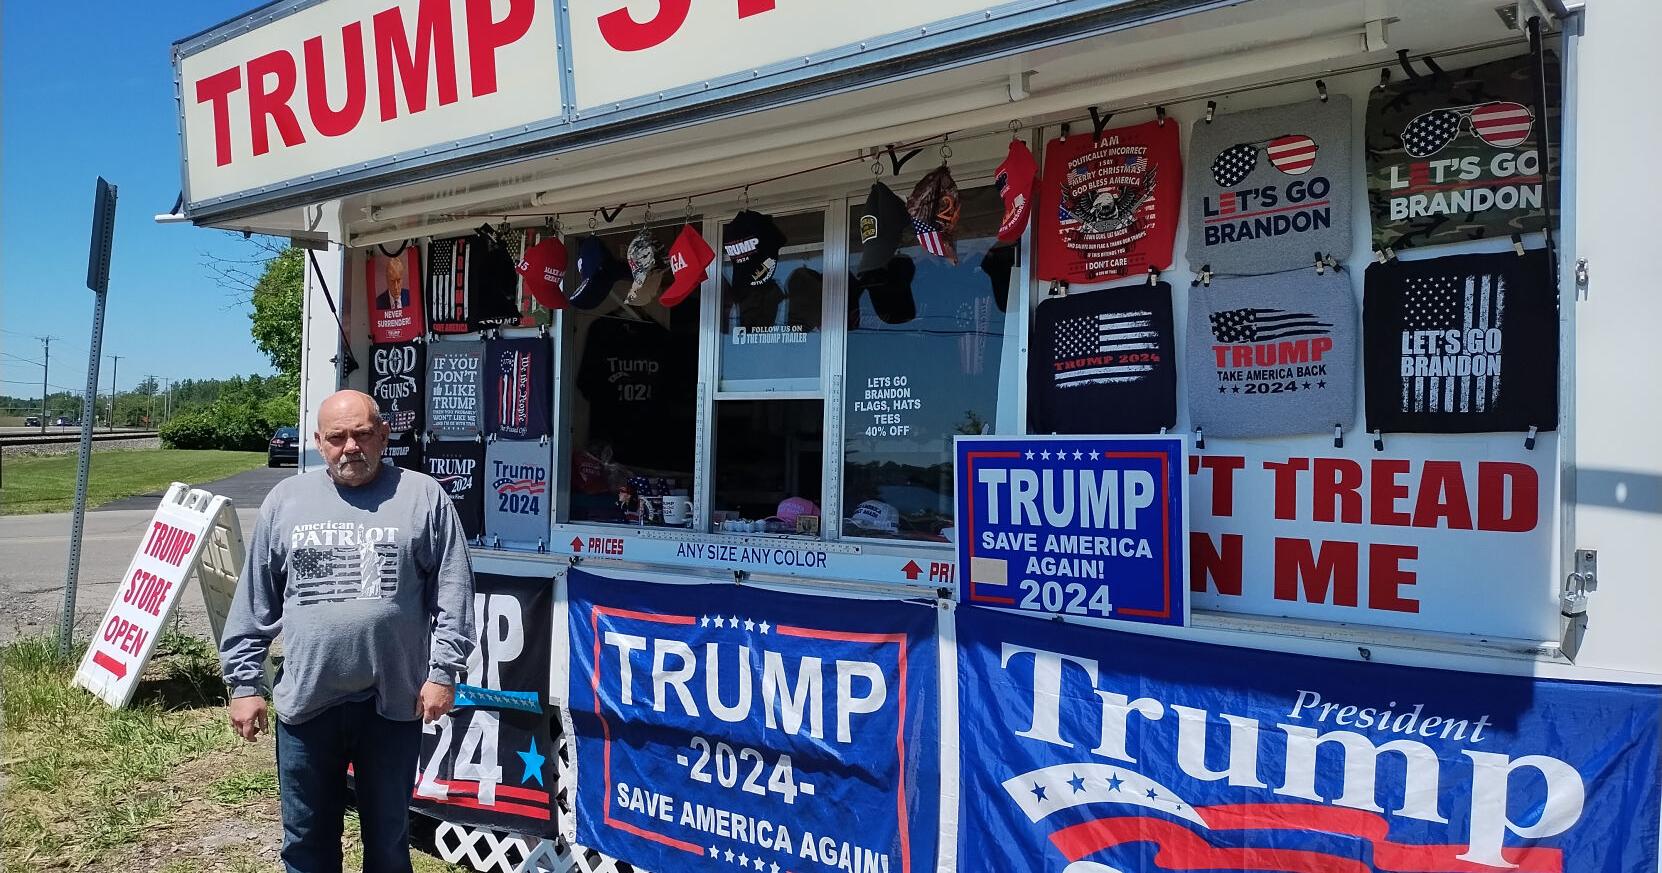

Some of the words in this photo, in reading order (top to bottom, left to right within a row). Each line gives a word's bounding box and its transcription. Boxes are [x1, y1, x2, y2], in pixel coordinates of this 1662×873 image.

[196, 0, 536, 167] TRUMP
[1100, 136, 1119, 148] AM
[1068, 149, 1108, 169] POLITICALLY
[1108, 146, 1148, 156] INCORRECT
[1071, 170, 1096, 186] MERRY
[1098, 165, 1141, 176] CHRISTMAS
[1390, 156, 1481, 189] LET'S
[1490, 150, 1540, 177] GO
[1072, 184, 1087, 197] GOD
[1088, 178, 1108, 190] BLESS
[1109, 176, 1140, 186] AMERICA
[1203, 186, 1278, 217] LET'S
[1286, 177, 1330, 202] GO
[1390, 185, 1542, 220] BRANDON
[1204, 208, 1330, 246] BRANDON
[1089, 260, 1109, 270] DON'T
[1110, 258, 1128, 267] CARE
[384, 310, 403, 319] NEVER
[747, 334, 758, 344] THE
[759, 333, 780, 344] TRUMP
[781, 332, 807, 343] TRAILER
[791, 324, 802, 332] ON
[1401, 329, 1460, 354] LET'S
[1467, 328, 1501, 354] GO
[374, 346, 416, 377] GOD
[1054, 356, 1113, 371] TRUMP
[1119, 353, 1160, 363] 2024
[1212, 337, 1333, 368] TRUMP
[433, 358, 446, 370] IF
[448, 358, 478, 370] YOU
[607, 357, 659, 376] Trump
[1217, 370, 1243, 381] TAKE
[1246, 368, 1293, 380] AMERICA
[1296, 364, 1327, 378] BACK
[1401, 355, 1501, 377] BRANDON
[433, 370, 477, 383] DON'T
[868, 377, 890, 388] LETS
[893, 376, 907, 387] GO
[1244, 380, 1298, 394] 2024
[380, 382, 410, 399] GUNS
[444, 384, 476, 396] LIKE
[864, 387, 911, 399] BRANDON
[391, 399, 400, 411] &
[432, 397, 476, 409] TRUMP
[854, 401, 890, 412] FLAGS,
[893, 399, 921, 410] HATS
[874, 414, 901, 424] TEES
[865, 426, 887, 437] 40%
[890, 426, 910, 436] OFF
[389, 446, 410, 456] TRUMP
[430, 458, 476, 475] TRUMP
[493, 460, 545, 483] Trump
[451, 476, 473, 493] 2024
[1263, 457, 1539, 533] TREAD
[499, 493, 540, 515] 2024
[978, 468, 1155, 530] TRUMP
[293, 520, 354, 532] American
[144, 521, 196, 568] TRUMP
[588, 537, 624, 555] PRICES
[982, 531, 1038, 552] SAVE
[1044, 534, 1153, 559] AMERICA
[677, 542, 705, 558] ANY
[707, 544, 737, 561] SIZE
[740, 548, 770, 564] ANY
[774, 549, 827, 569] COLOR
[1026, 556, 1104, 579] AGAIN!
[1273, 536, 1421, 614] ME
[123, 568, 173, 617] STORE
[1020, 579, 1113, 616] 2024
[103, 615, 148, 658] OPEN
[605, 631, 887, 743] TRUMP
[1286, 689, 1493, 744] President
[415, 711, 503, 806] 24
[1001, 641, 1586, 869] Trump
[617, 782, 673, 822] SAVE
[680, 800, 793, 854] AMERICA
